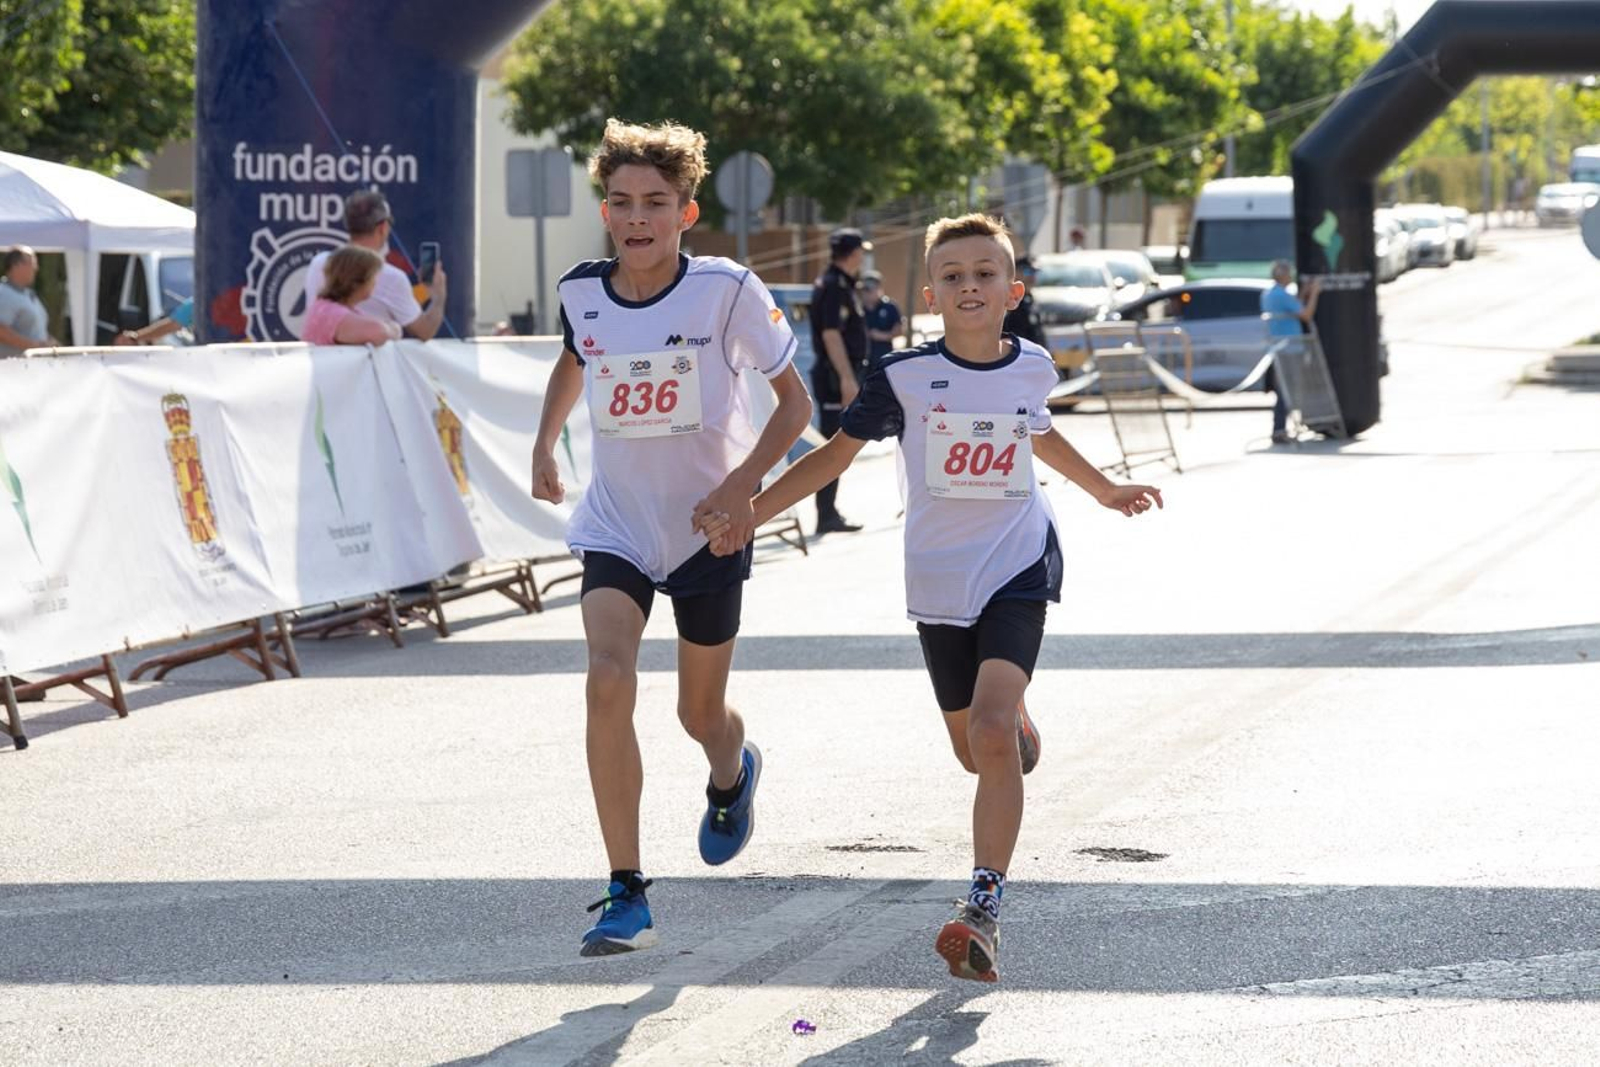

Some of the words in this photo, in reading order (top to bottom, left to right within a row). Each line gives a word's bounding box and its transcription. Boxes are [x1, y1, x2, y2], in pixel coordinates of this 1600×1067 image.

[233, 142, 418, 183] fundación
[609, 379, 679, 417] 836
[944, 442, 1017, 476] 804
